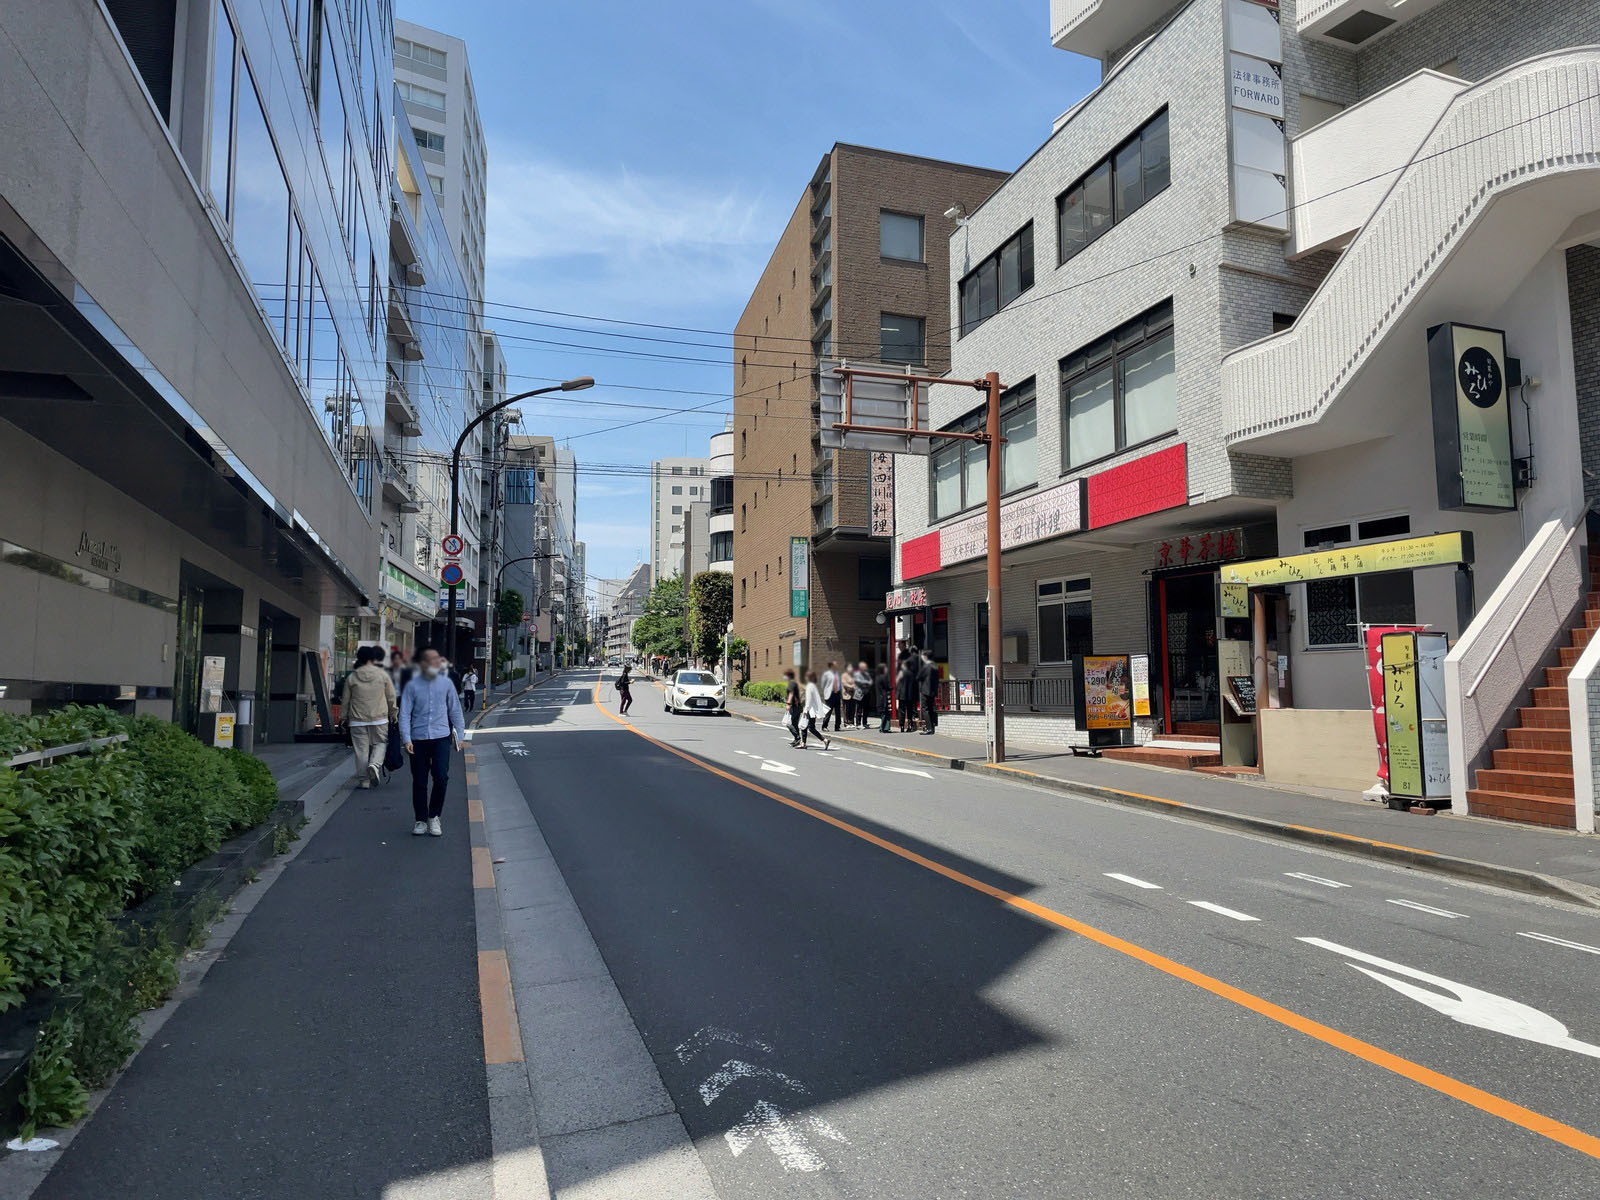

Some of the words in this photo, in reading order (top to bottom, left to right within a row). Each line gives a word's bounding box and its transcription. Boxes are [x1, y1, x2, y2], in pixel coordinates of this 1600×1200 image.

[1233, 69, 1280, 90] 法律事務所
[1233, 86, 1280, 106] FORWARD
[1464, 361, 1487, 399] みひろ
[1279, 560, 1304, 580] みひろ
[1086, 668, 1106, 677] 生ビール
[1391, 665, 1405, 709] みひろ
[1088, 696, 1107, 705] ¥290
